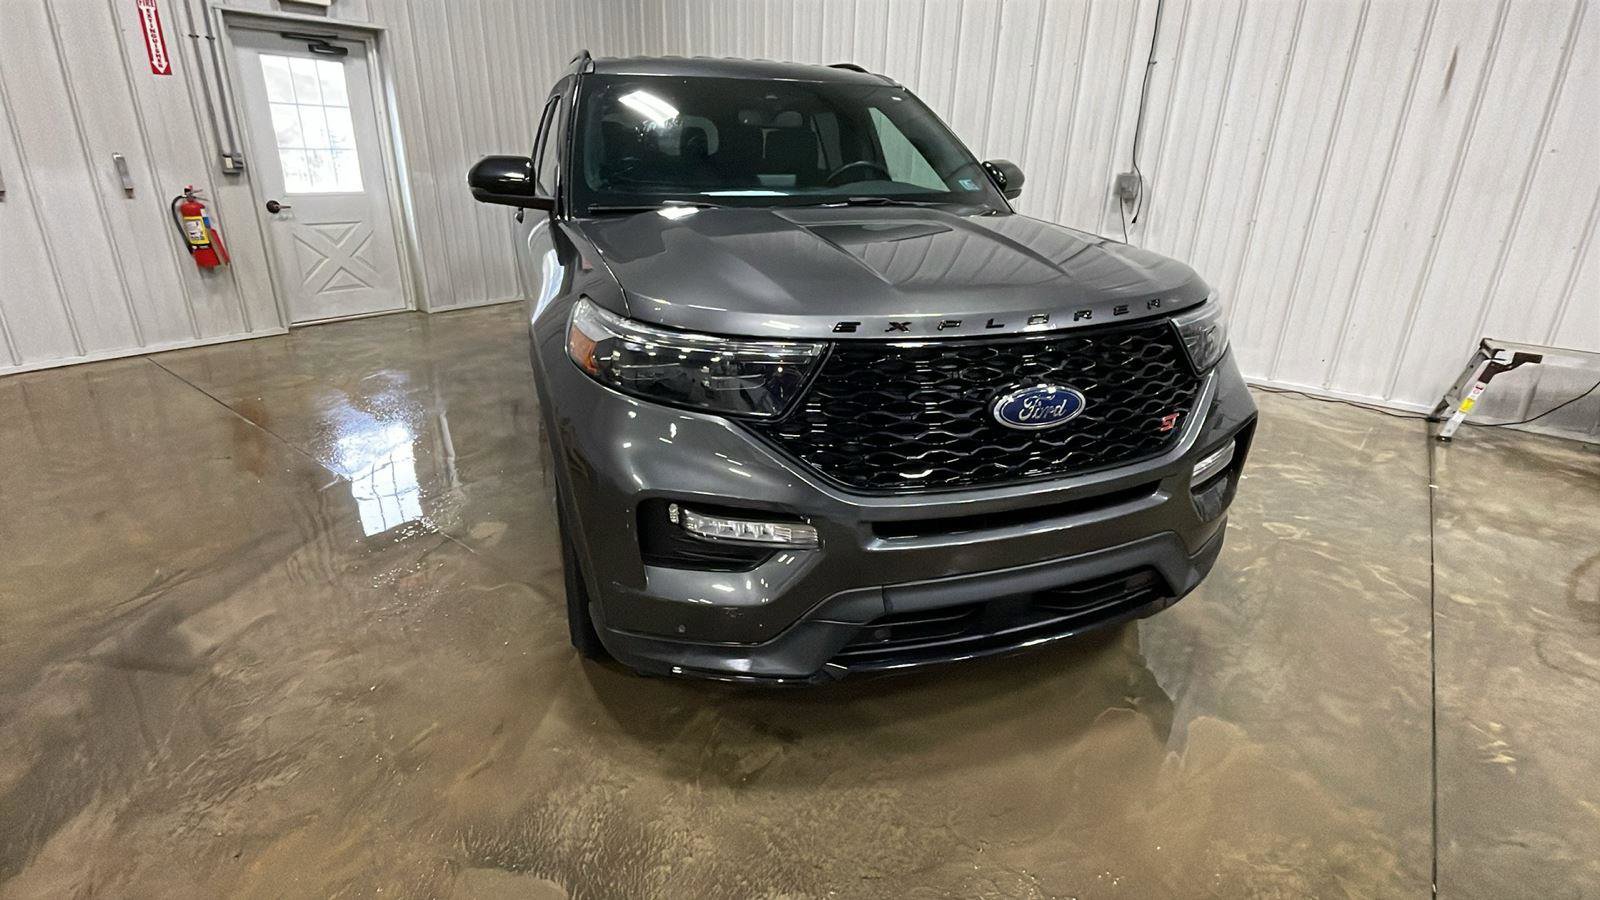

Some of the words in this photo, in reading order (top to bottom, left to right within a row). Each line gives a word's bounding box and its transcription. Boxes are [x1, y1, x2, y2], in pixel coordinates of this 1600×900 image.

[146, 8, 163, 68] EXTINGUISHER
[832, 298, 1161, 333] EXPLORER
[1018, 396, 1067, 421] Ford
[1160, 412, 1179, 431] ST
